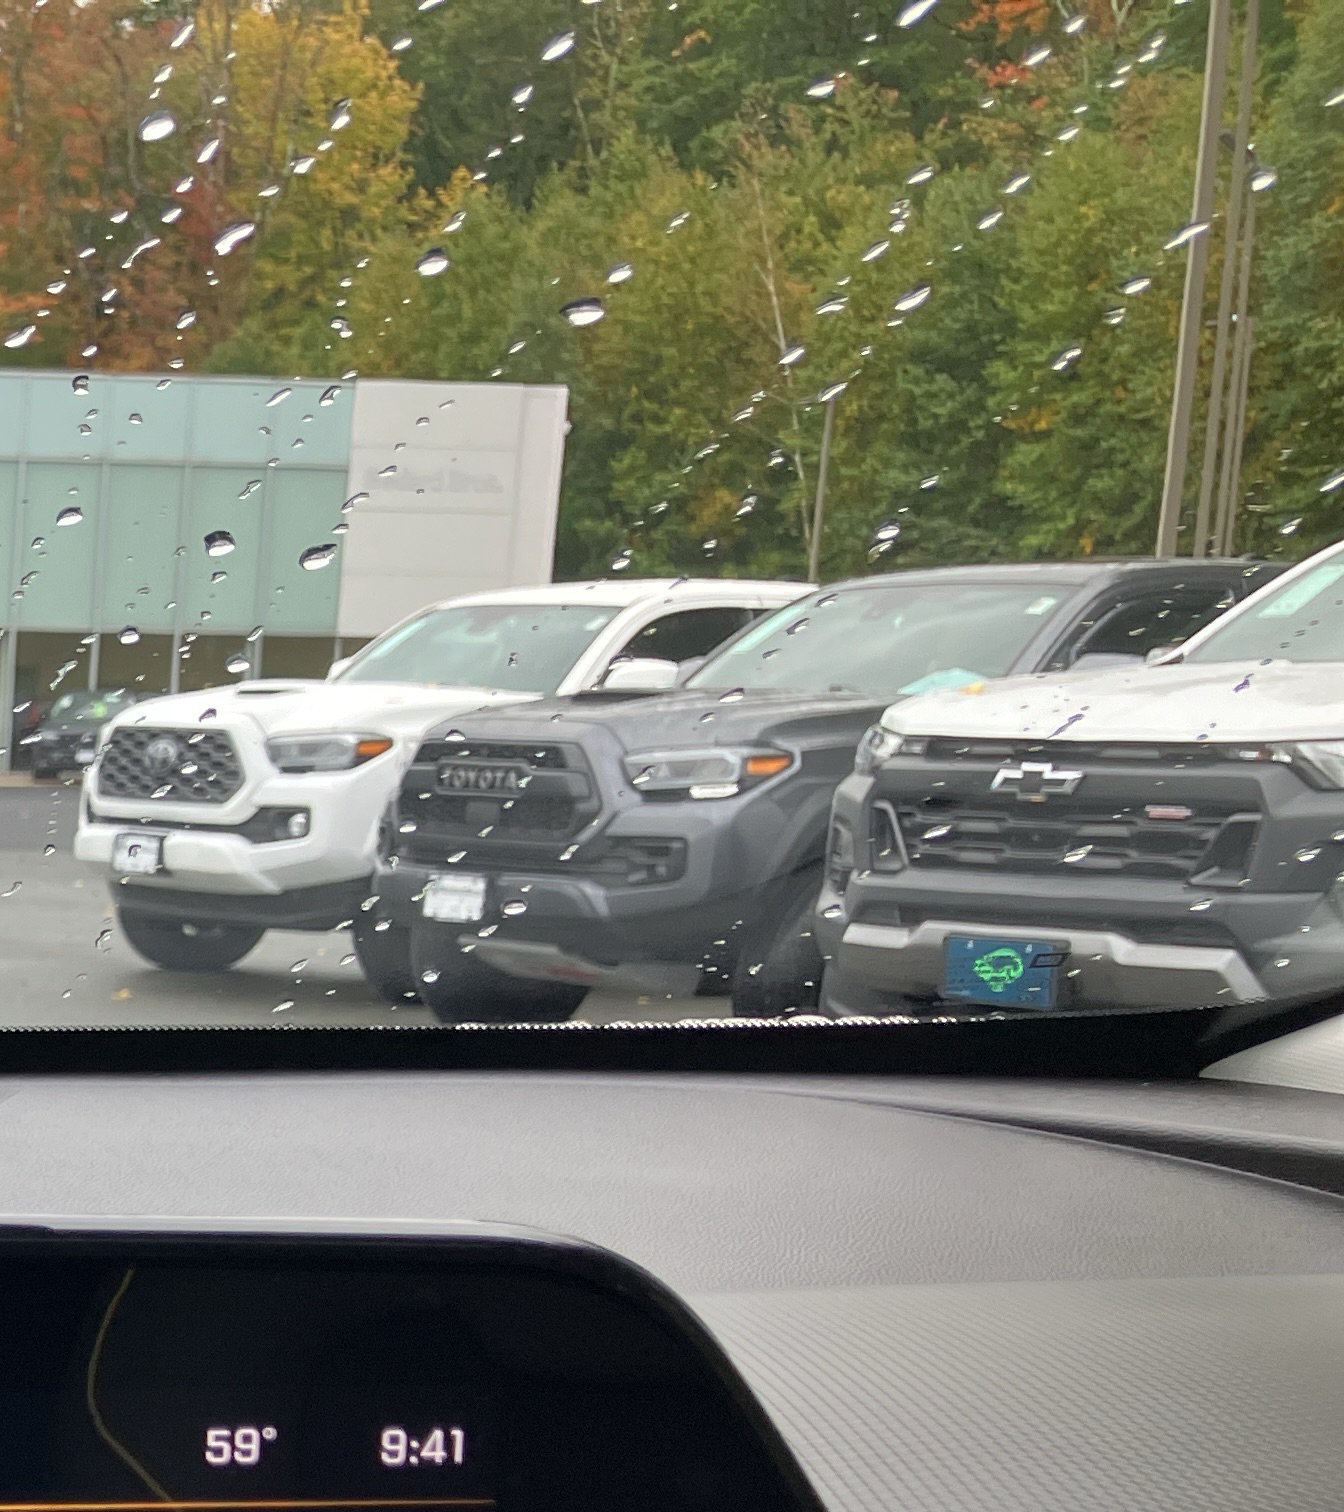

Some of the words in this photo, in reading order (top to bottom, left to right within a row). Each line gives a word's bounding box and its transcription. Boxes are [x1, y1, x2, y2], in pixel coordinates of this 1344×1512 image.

[441, 768, 518, 790] TOYOTA
[205, 1426, 279, 1465] 59°
[380, 1427, 465, 1465] 9:41
